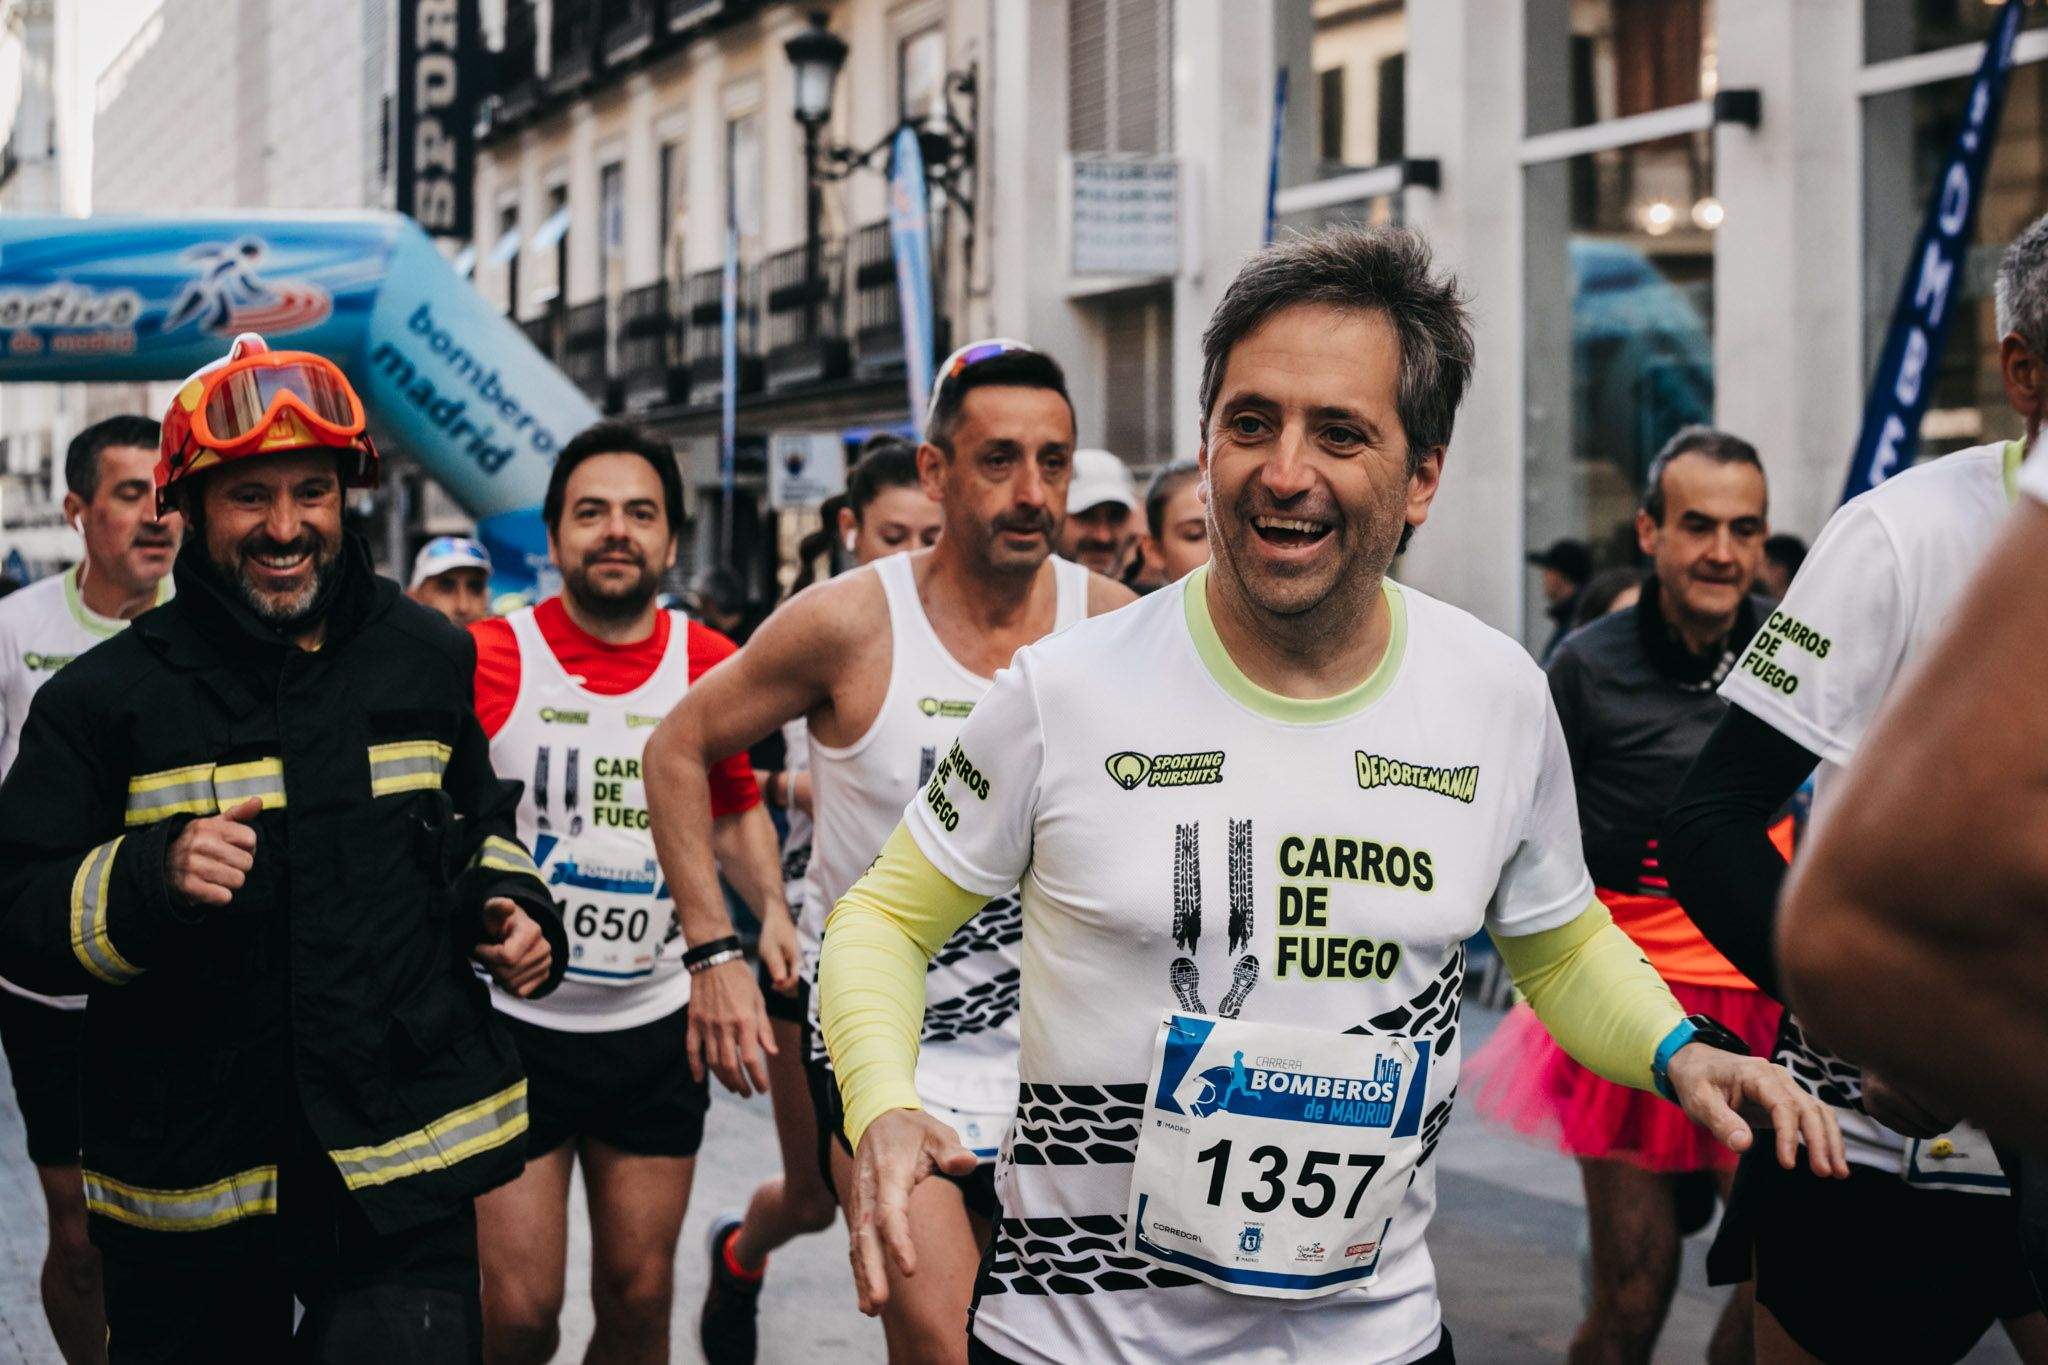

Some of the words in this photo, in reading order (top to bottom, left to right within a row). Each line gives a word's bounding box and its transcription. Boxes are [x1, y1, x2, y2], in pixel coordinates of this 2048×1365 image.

[373, 343, 515, 475] madrid
[1754, 631, 1782, 657] DE
[1768, 611, 1831, 659] CARROS
[1741, 652, 1798, 694] FUEGO
[1149, 768, 1218, 786] PURSUITS
[1152, 752, 1225, 771] SPORTING
[1355, 750, 1479, 804] DEPORTEMANIA
[594, 783, 622, 802] DE
[594, 807, 650, 830] FUEG
[1279, 836, 1434, 892] CARROS
[1278, 886, 1328, 927] DE
[1276, 936, 1400, 980] FUEGO
[1255, 1056, 1302, 1071] CARRERA
[1251, 1070, 1395, 1103] BOMBEROS
[1165, 1122, 1191, 1135] MADRID
[1304, 1100, 1323, 1119] de
[1329, 1100, 1391, 1125] MADRID
[1197, 1139, 1386, 1219] 1357
